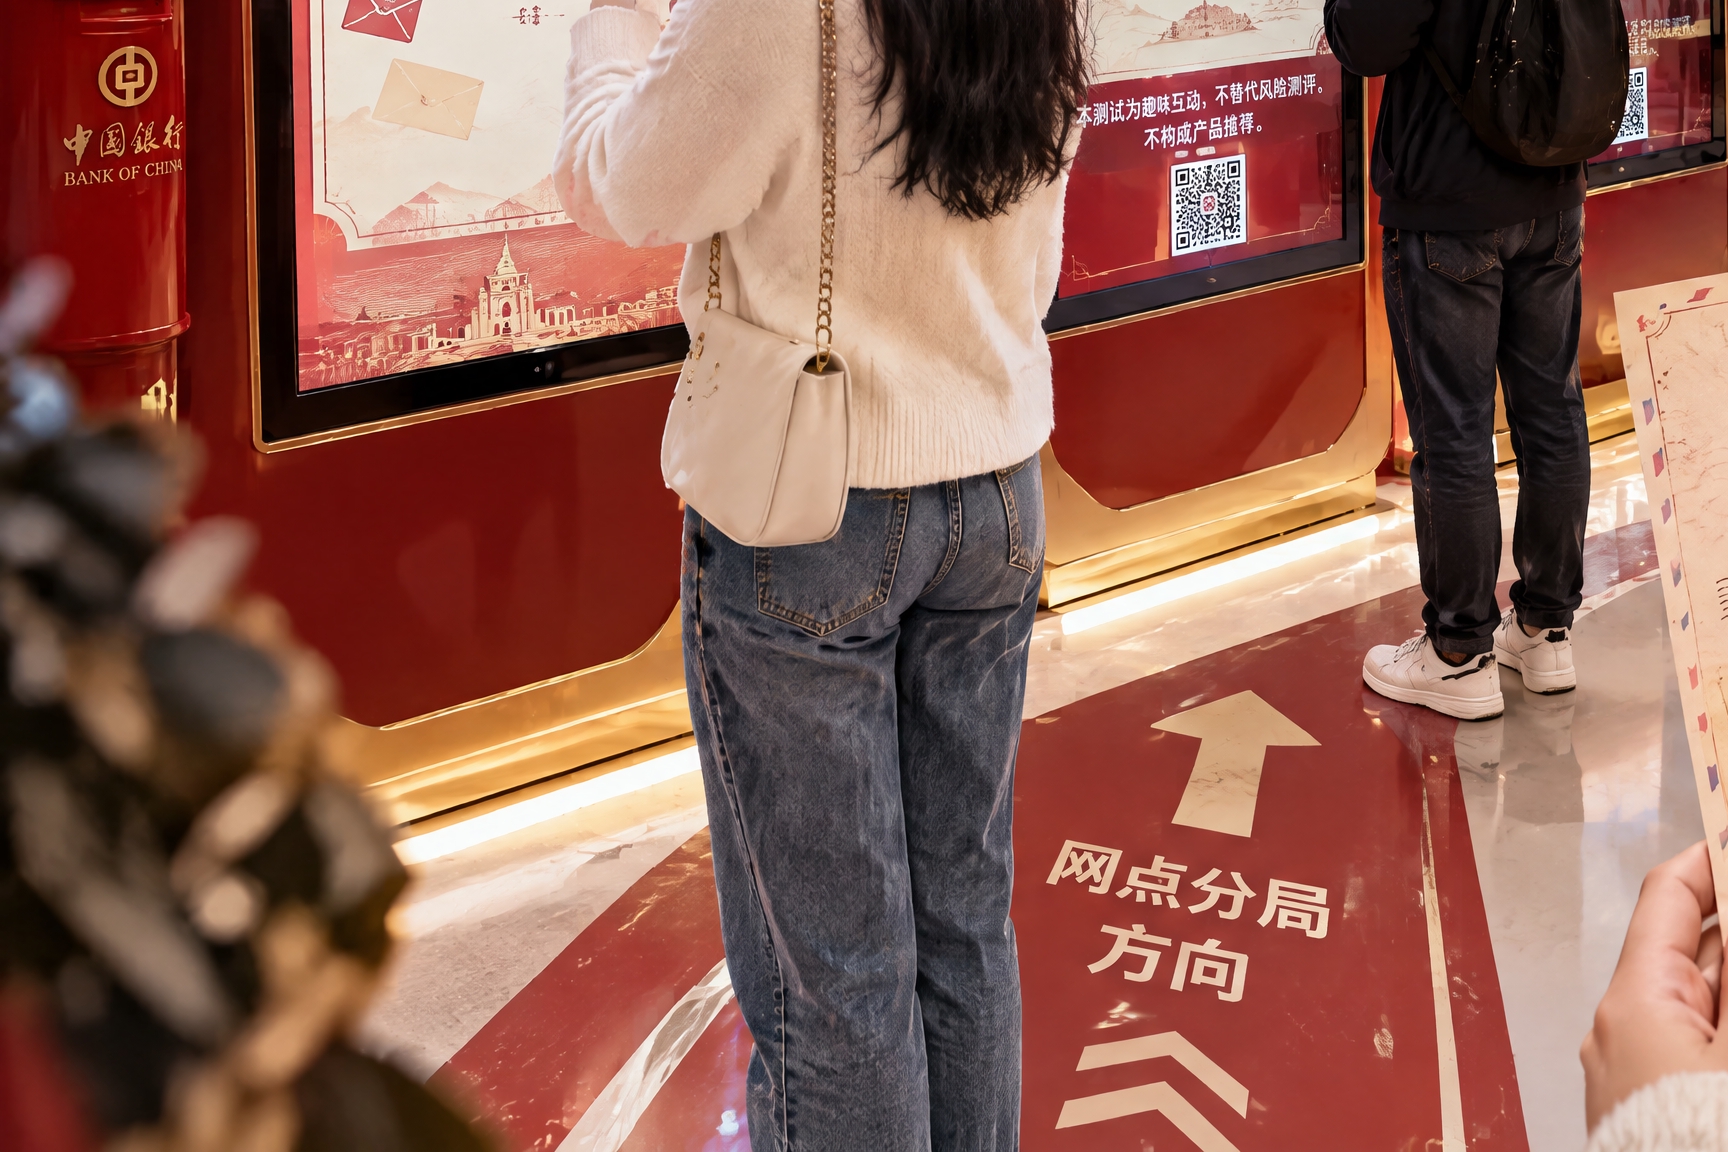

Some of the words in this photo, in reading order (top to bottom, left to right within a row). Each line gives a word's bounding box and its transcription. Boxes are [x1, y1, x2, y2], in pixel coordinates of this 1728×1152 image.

[64, 168, 114, 186] BANK
[119, 165, 140, 181] OF
[144, 158, 183, 177] CHINA
[1046, 839, 1331, 939] 网点分局
[1087, 923, 1250, 1003] 方向
